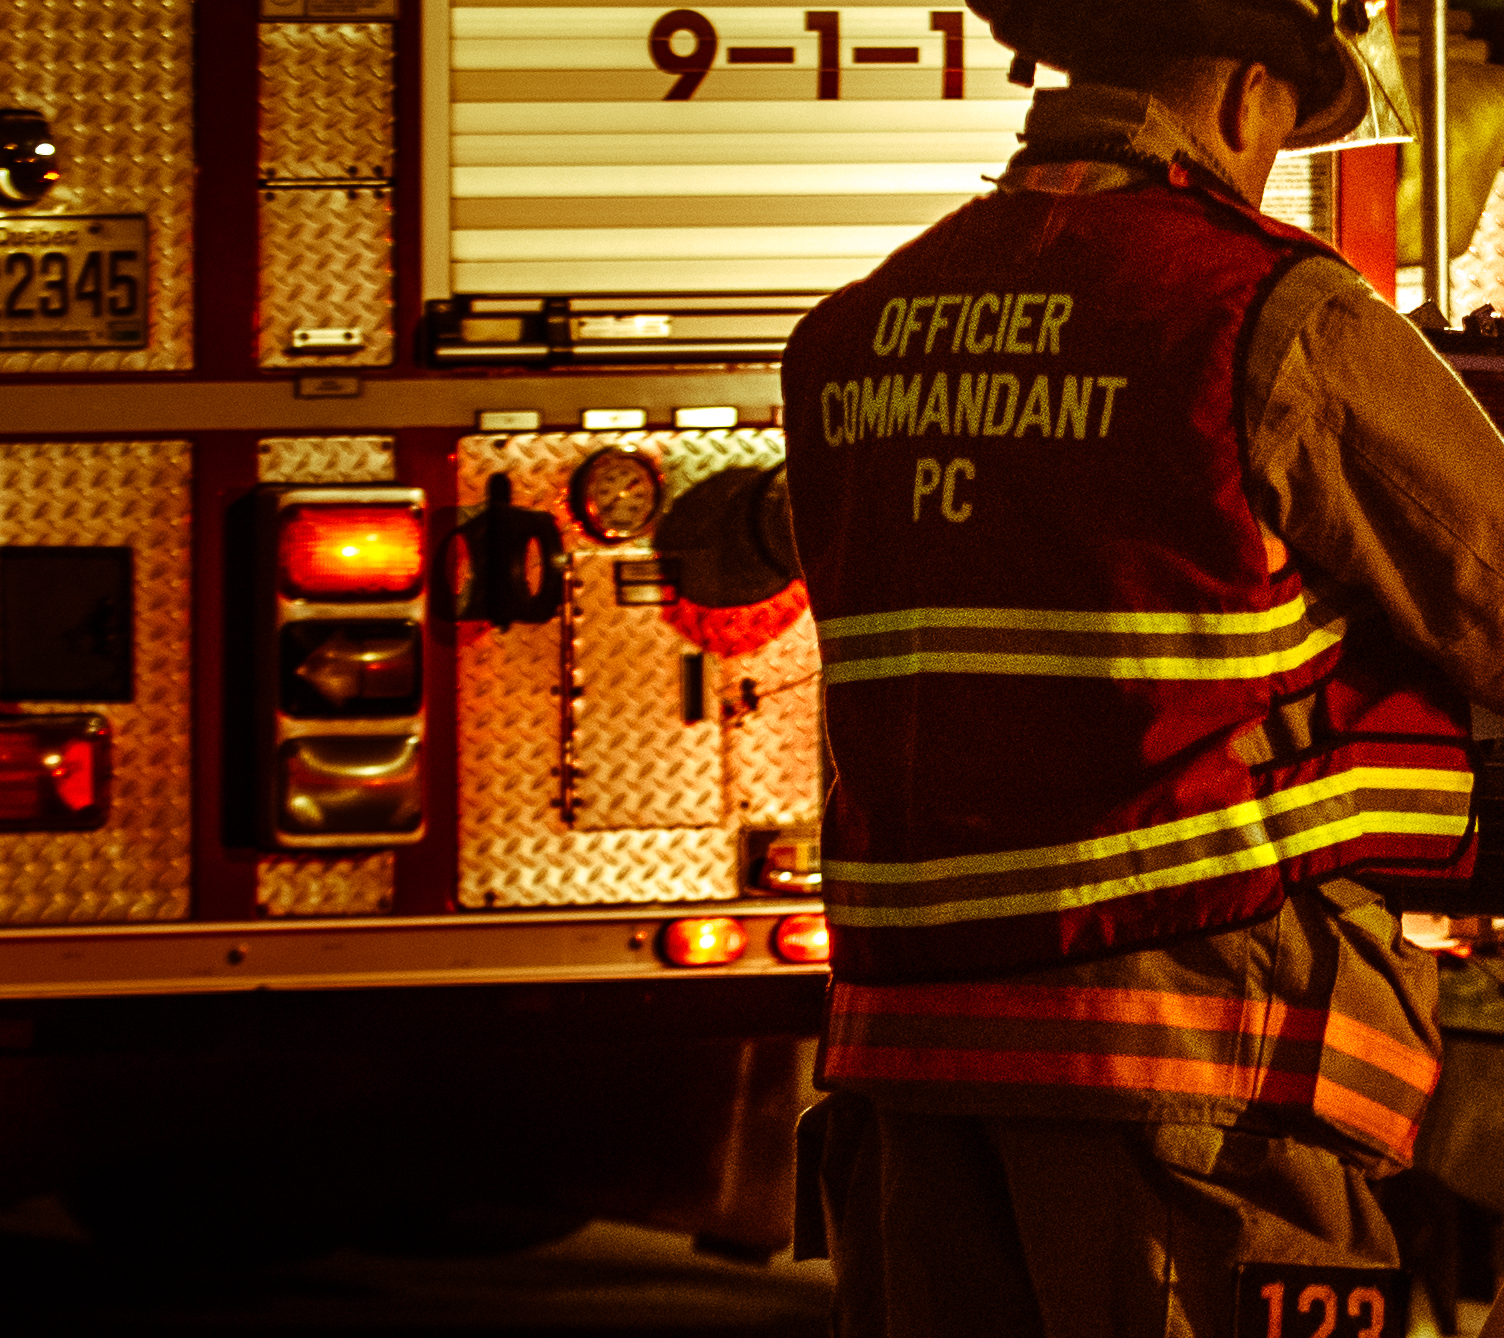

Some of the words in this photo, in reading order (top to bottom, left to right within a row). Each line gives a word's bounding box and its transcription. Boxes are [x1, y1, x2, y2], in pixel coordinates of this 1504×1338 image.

[647, 8, 965, 101] 9-1-1
[871, 292, 1075, 358] OFFICIER
[820, 371, 1129, 448] COMMANDANT
[911, 457, 977, 523] PC
